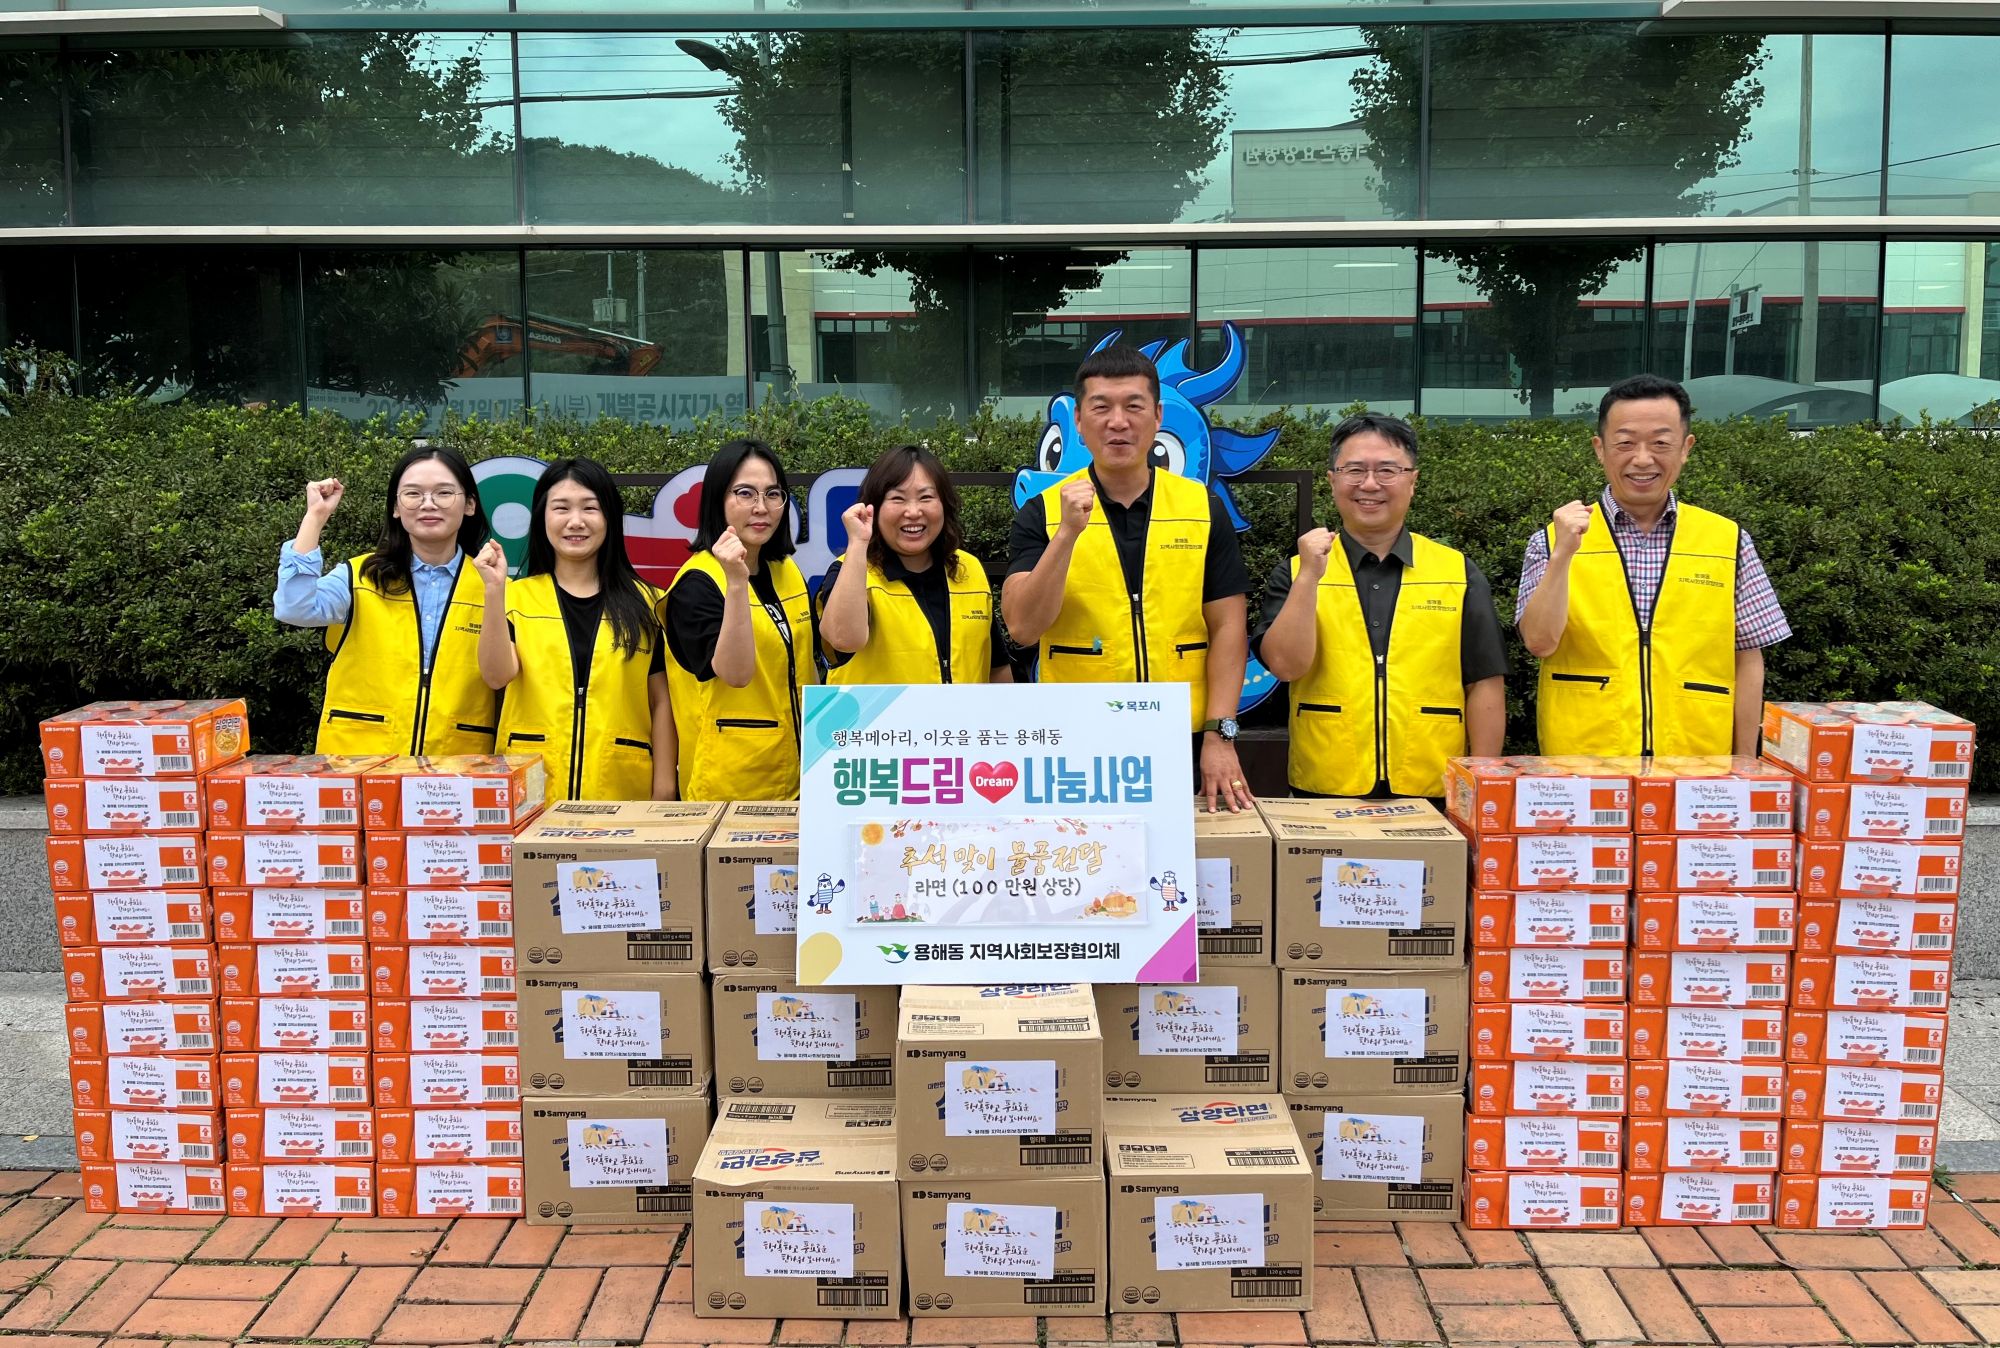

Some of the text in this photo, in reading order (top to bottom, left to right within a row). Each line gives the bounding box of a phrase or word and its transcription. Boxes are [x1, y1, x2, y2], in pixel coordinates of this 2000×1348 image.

[596, 393, 718, 420] 개별공시지가
[1126, 700, 1161, 712] 목포시
[832, 728, 1063, 747] 행복메아리, 이웃을 품는 용해동
[833, 755, 1152, 806] 행복드림 나눔사업
[975, 775, 1013, 787] Dream
[1333, 805, 1416, 818] 삼양라면
[537, 852, 577, 860] Samyang
[1302, 848, 1342, 856] Samyang
[732, 856, 772, 864] Samyang
[900, 840, 1107, 876] 추석 맞이 물품전달
[915, 878, 946, 897] 라면
[1005, 877, 1037, 897] 만원
[1042, 877, 1081, 897] 상당)
[914, 942, 1121, 960] 용해동 지역사회보장협의체
[538, 980, 578, 989] Samyang
[1307, 978, 1347, 986] Samyang
[737, 984, 777, 993] Samyang
[922, 1050, 966, 1058] Samyang
[1178, 1102, 1268, 1122] 삼양라면
[1304, 1104, 1343, 1112] Samyang
[546, 1110, 586, 1118] Samyang
[1136, 1185, 1179, 1194] Samyang
[927, 1191, 971, 1200] Samyang
